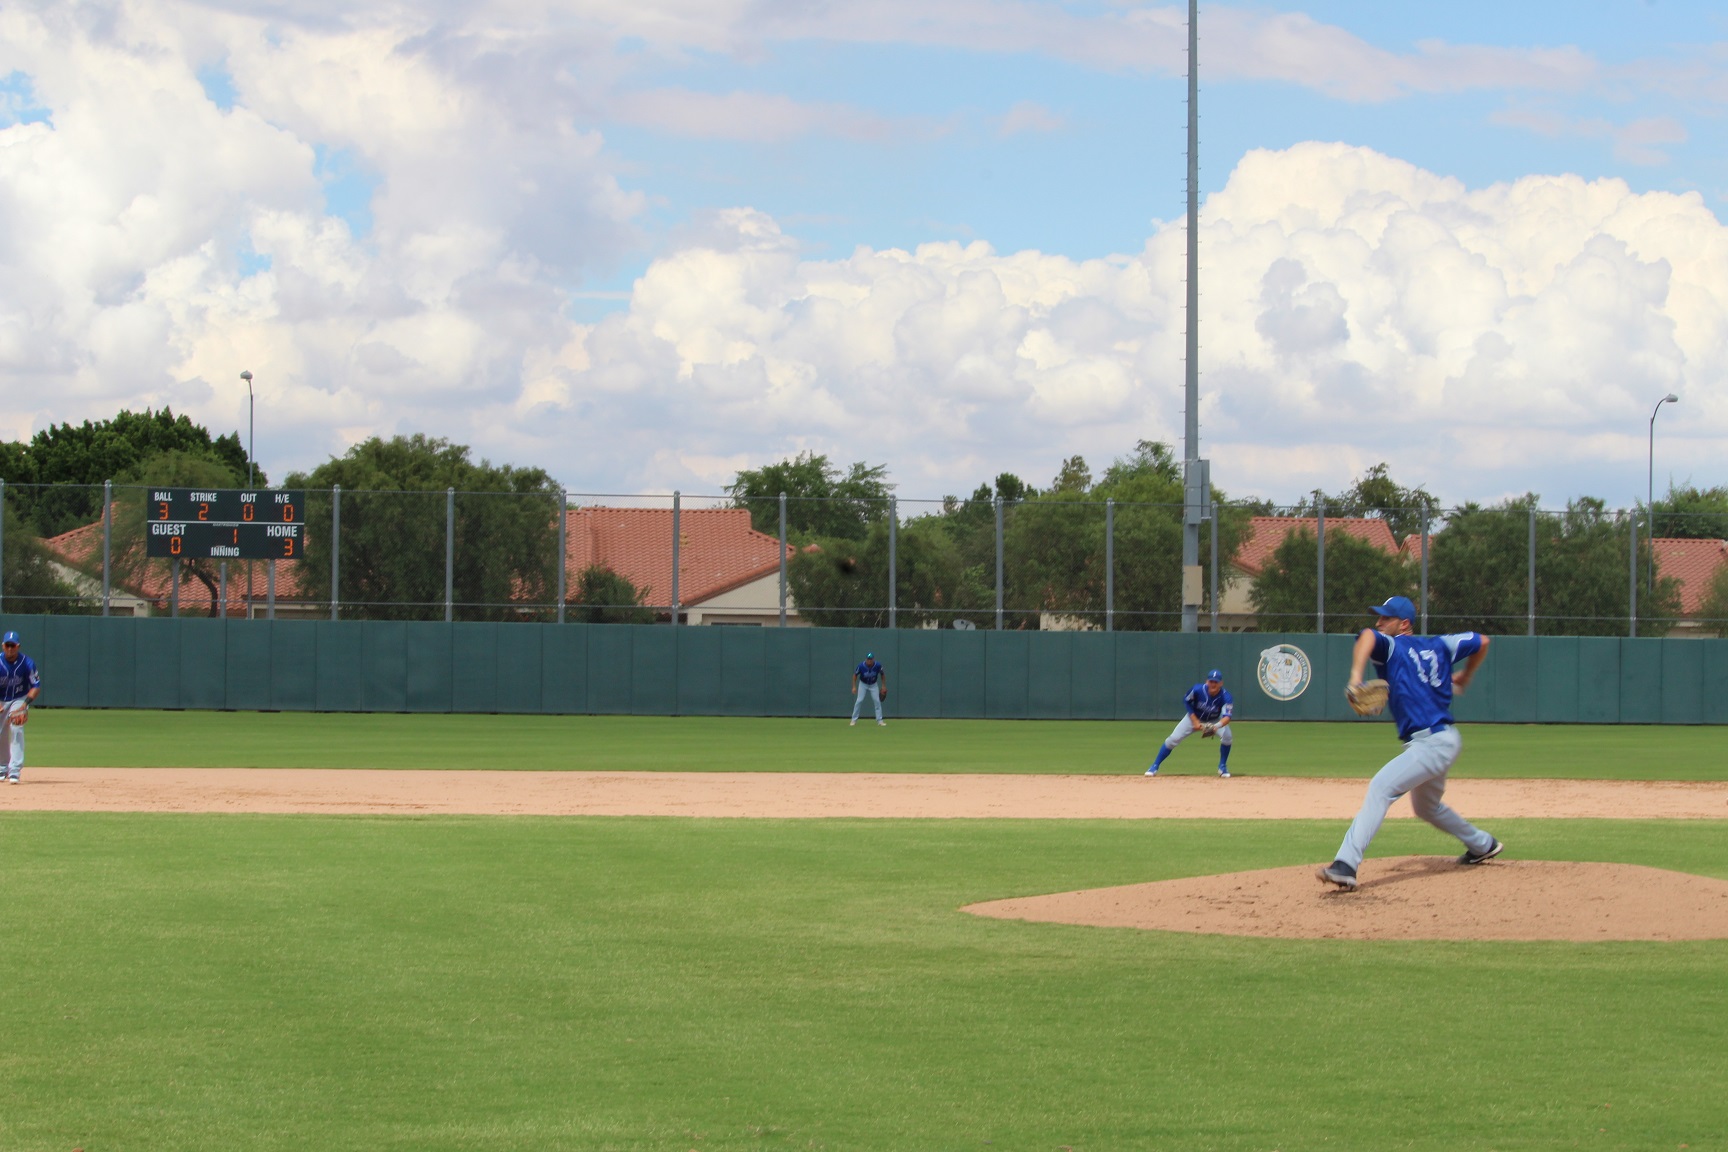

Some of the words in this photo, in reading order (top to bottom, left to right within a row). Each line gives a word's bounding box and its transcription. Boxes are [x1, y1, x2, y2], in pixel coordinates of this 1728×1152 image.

[154, 492, 172, 502] BALL
[190, 492, 217, 502] STRIKE
[240, 493, 257, 503] OUT
[275, 494, 290, 504] H/E
[159, 502, 169, 520] 3
[198, 503, 209, 521] 2
[243, 503, 254, 522] 0
[283, 504, 294, 522] 0
[152, 524, 186, 535] GUEST
[267, 526, 298, 537] HOME
[233, 528, 239, 544] 1
[170, 536, 181, 555] 0
[284, 538, 294, 557] 3
[210, 547, 240, 557] INNING
[1408, 647, 1442, 688] 17
